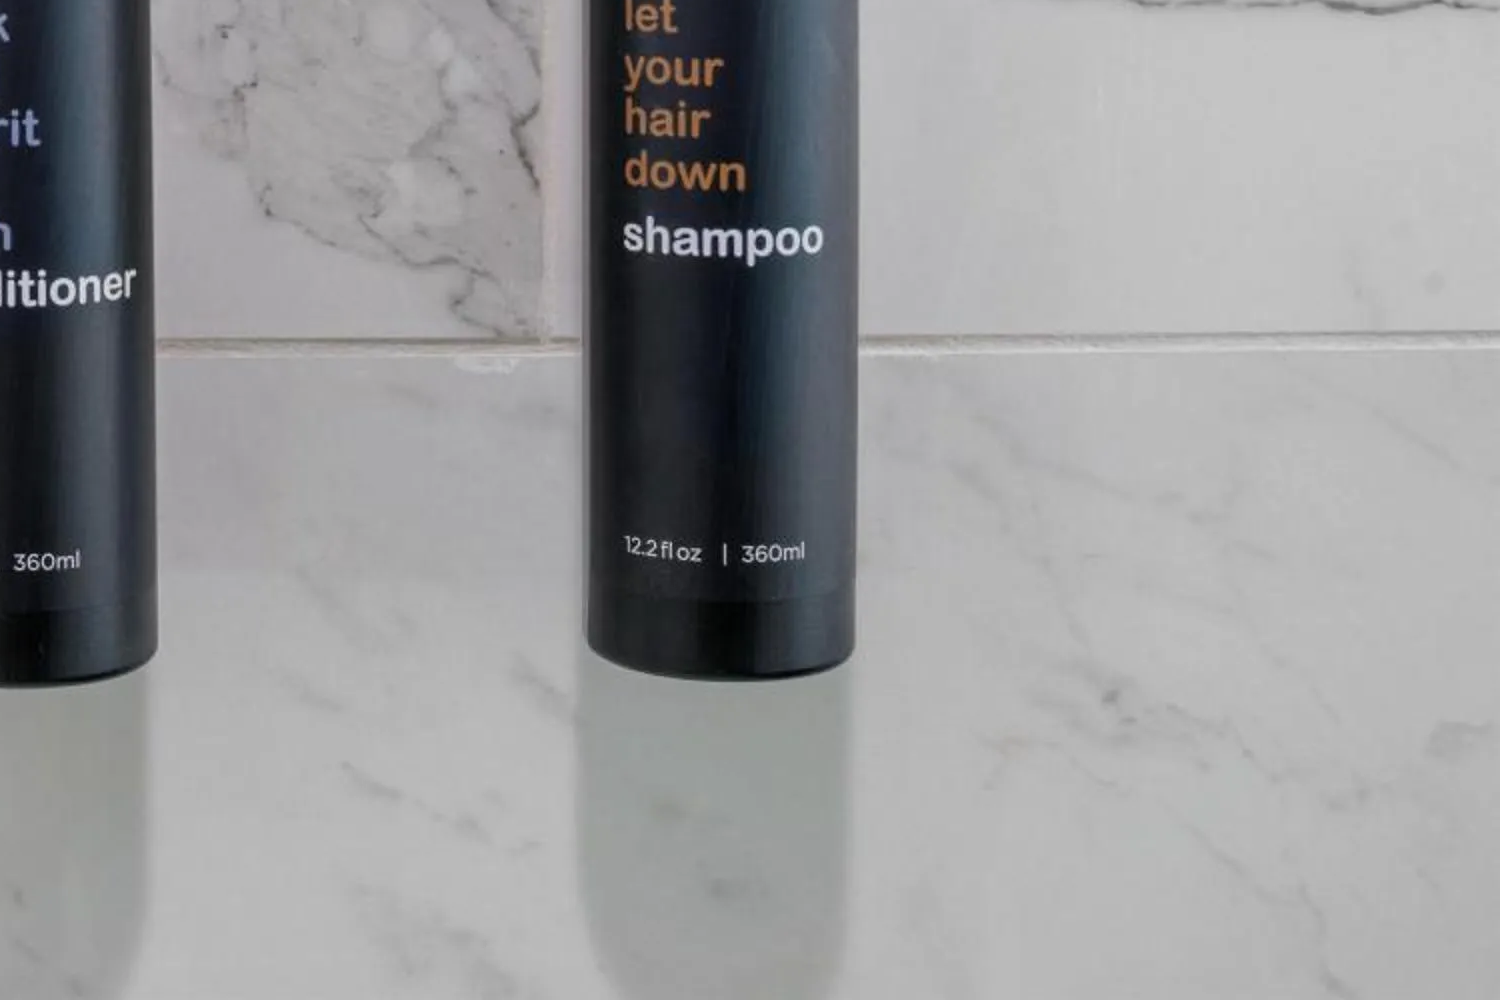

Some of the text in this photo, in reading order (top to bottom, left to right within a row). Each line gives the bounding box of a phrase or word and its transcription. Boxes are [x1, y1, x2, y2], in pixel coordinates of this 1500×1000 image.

[624, 54, 724, 91] your
[624, 96, 710, 138] hair
[624, 149, 746, 191] down
[623, 216, 823, 267] shampoo
[13, 549, 81, 571] 360ml
[741, 541, 805, 563] 360ml
